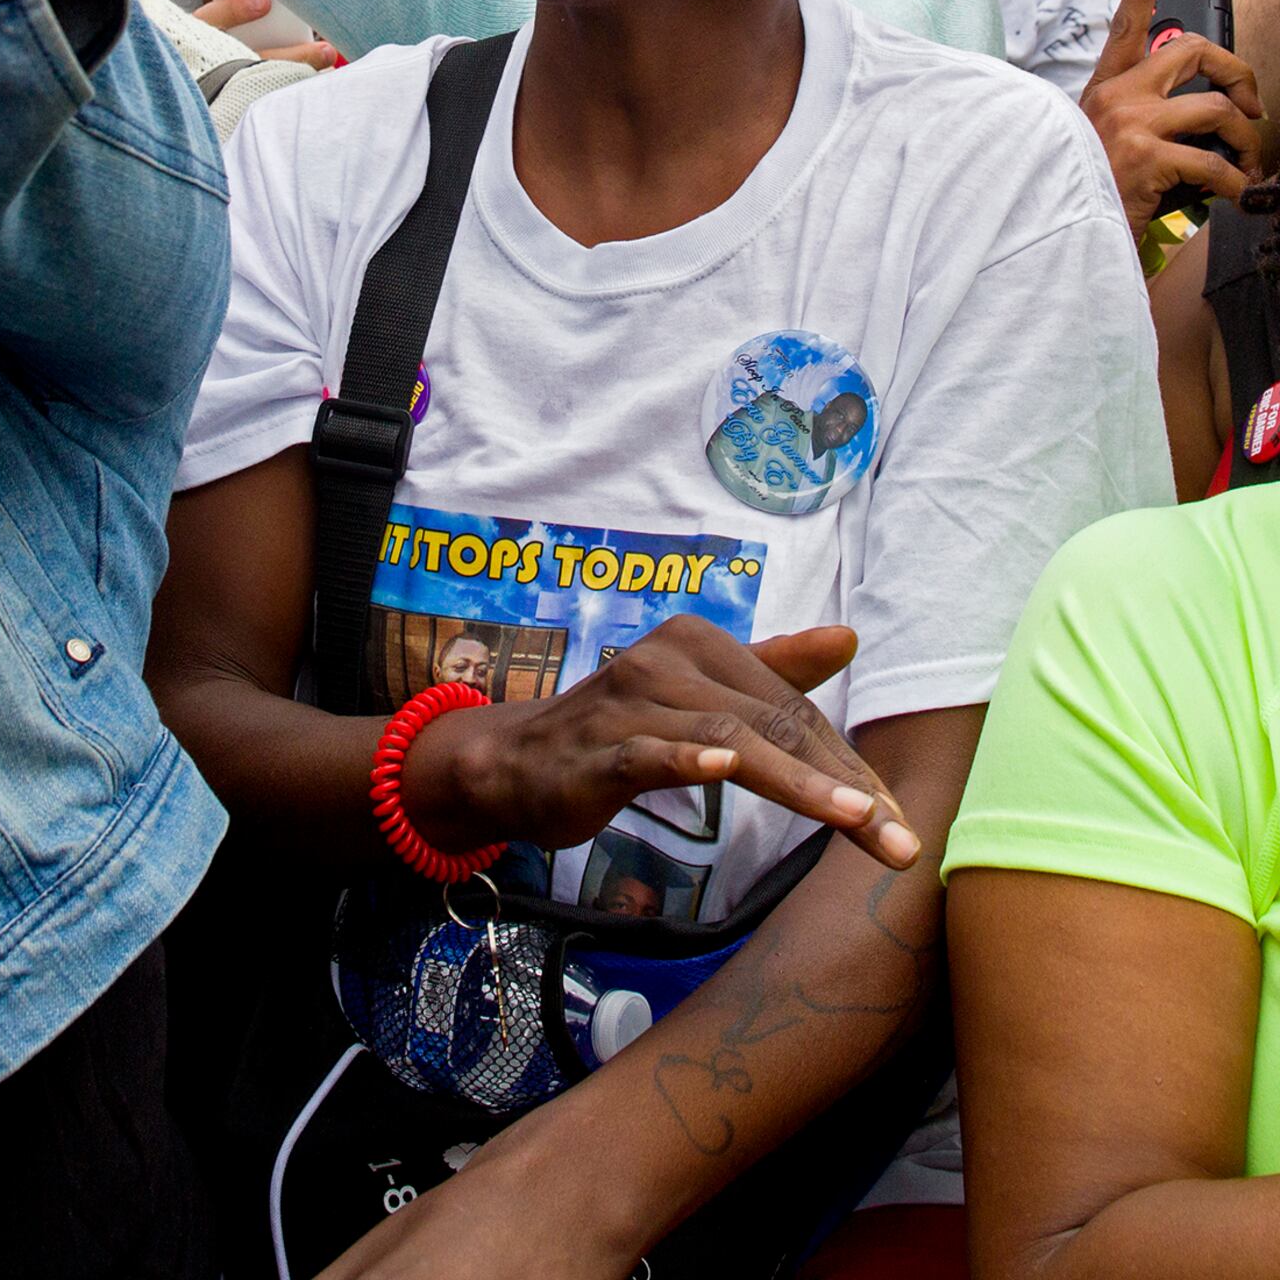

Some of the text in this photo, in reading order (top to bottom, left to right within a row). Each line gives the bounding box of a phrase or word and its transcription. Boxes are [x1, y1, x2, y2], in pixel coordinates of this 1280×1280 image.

[735, 353, 763, 382] Sleep
[780, 400, 811, 435] Peace
[1250, 387, 1274, 457] ERIC GARNER
[1266, 403, 1280, 430] FOR
[730, 377, 765, 424] Eric
[759, 418, 825, 485] Garner
[378, 523, 412, 565] IT
[410, 527, 544, 585] STOPS
[553, 544, 716, 595] TODAY
